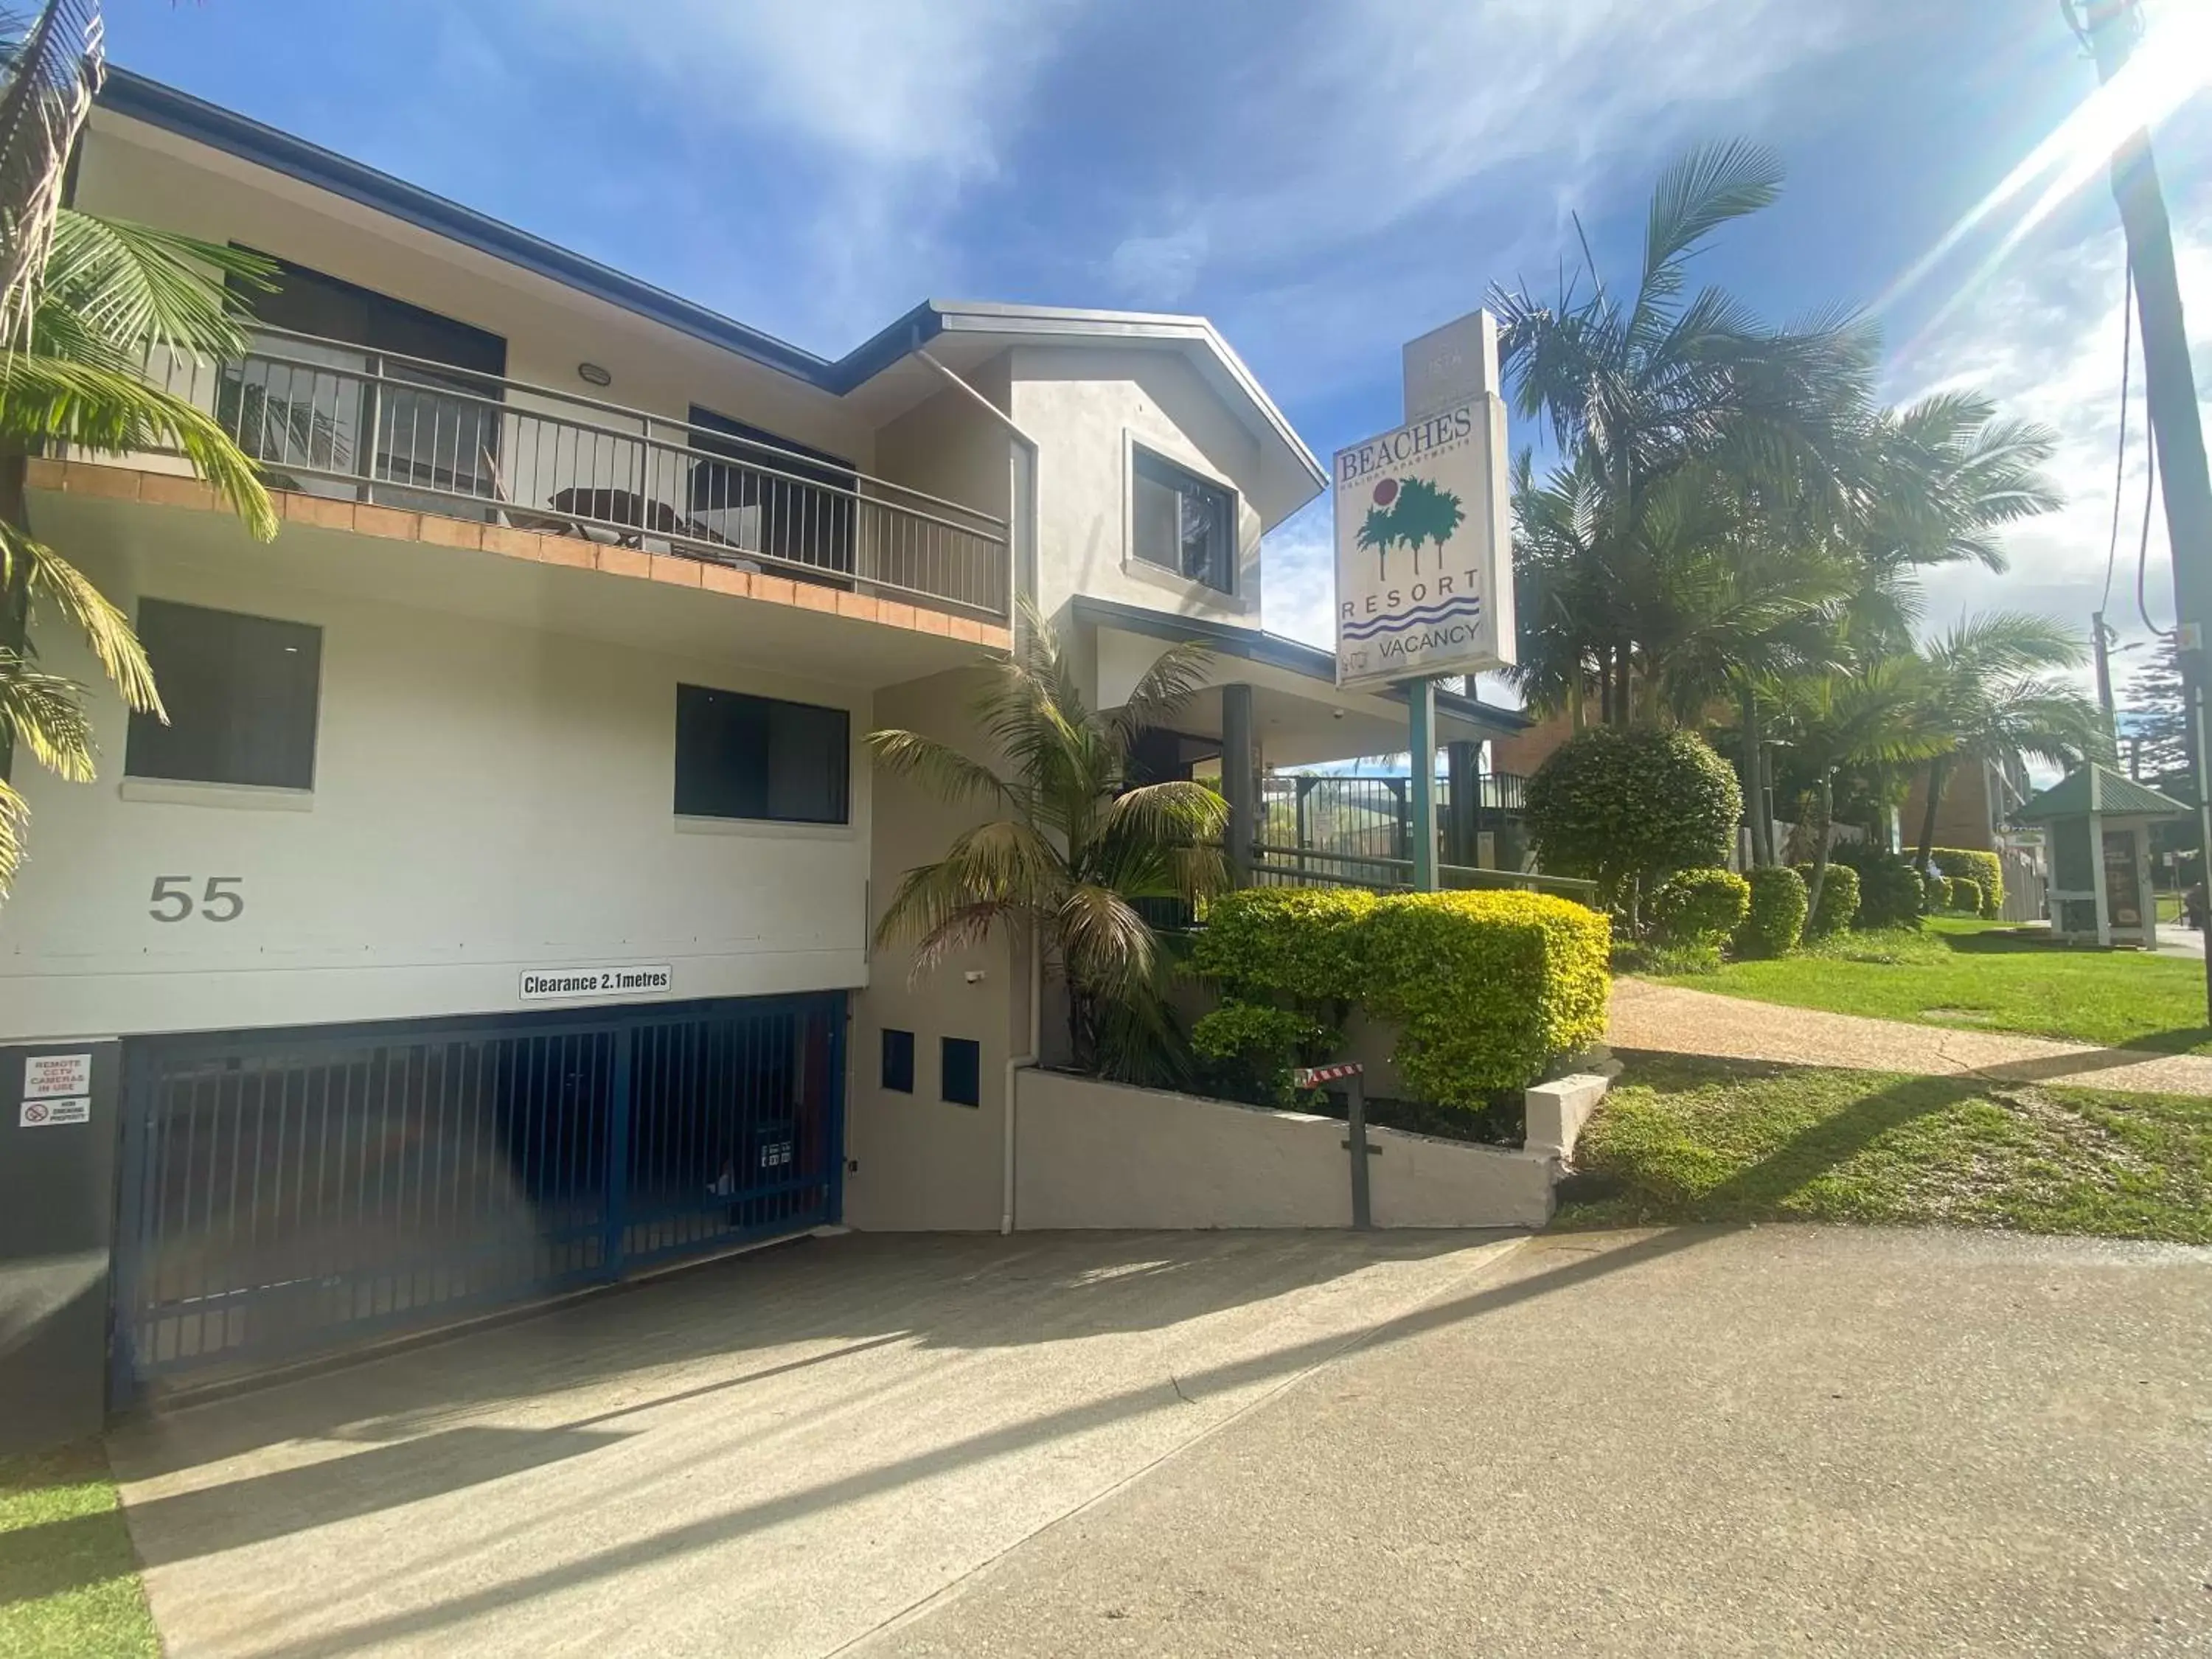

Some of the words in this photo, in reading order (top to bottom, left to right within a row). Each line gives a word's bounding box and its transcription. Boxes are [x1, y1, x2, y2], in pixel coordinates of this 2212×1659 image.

[1340, 408, 1471, 481] BEACHES
[1342, 569, 1478, 619] RESORT
[1379, 622, 1480, 658] VACANCY
[149, 875, 243, 922] 55
[524, 976, 597, 993] Clearance
[30, 1074, 84, 1084] CAMERAS
